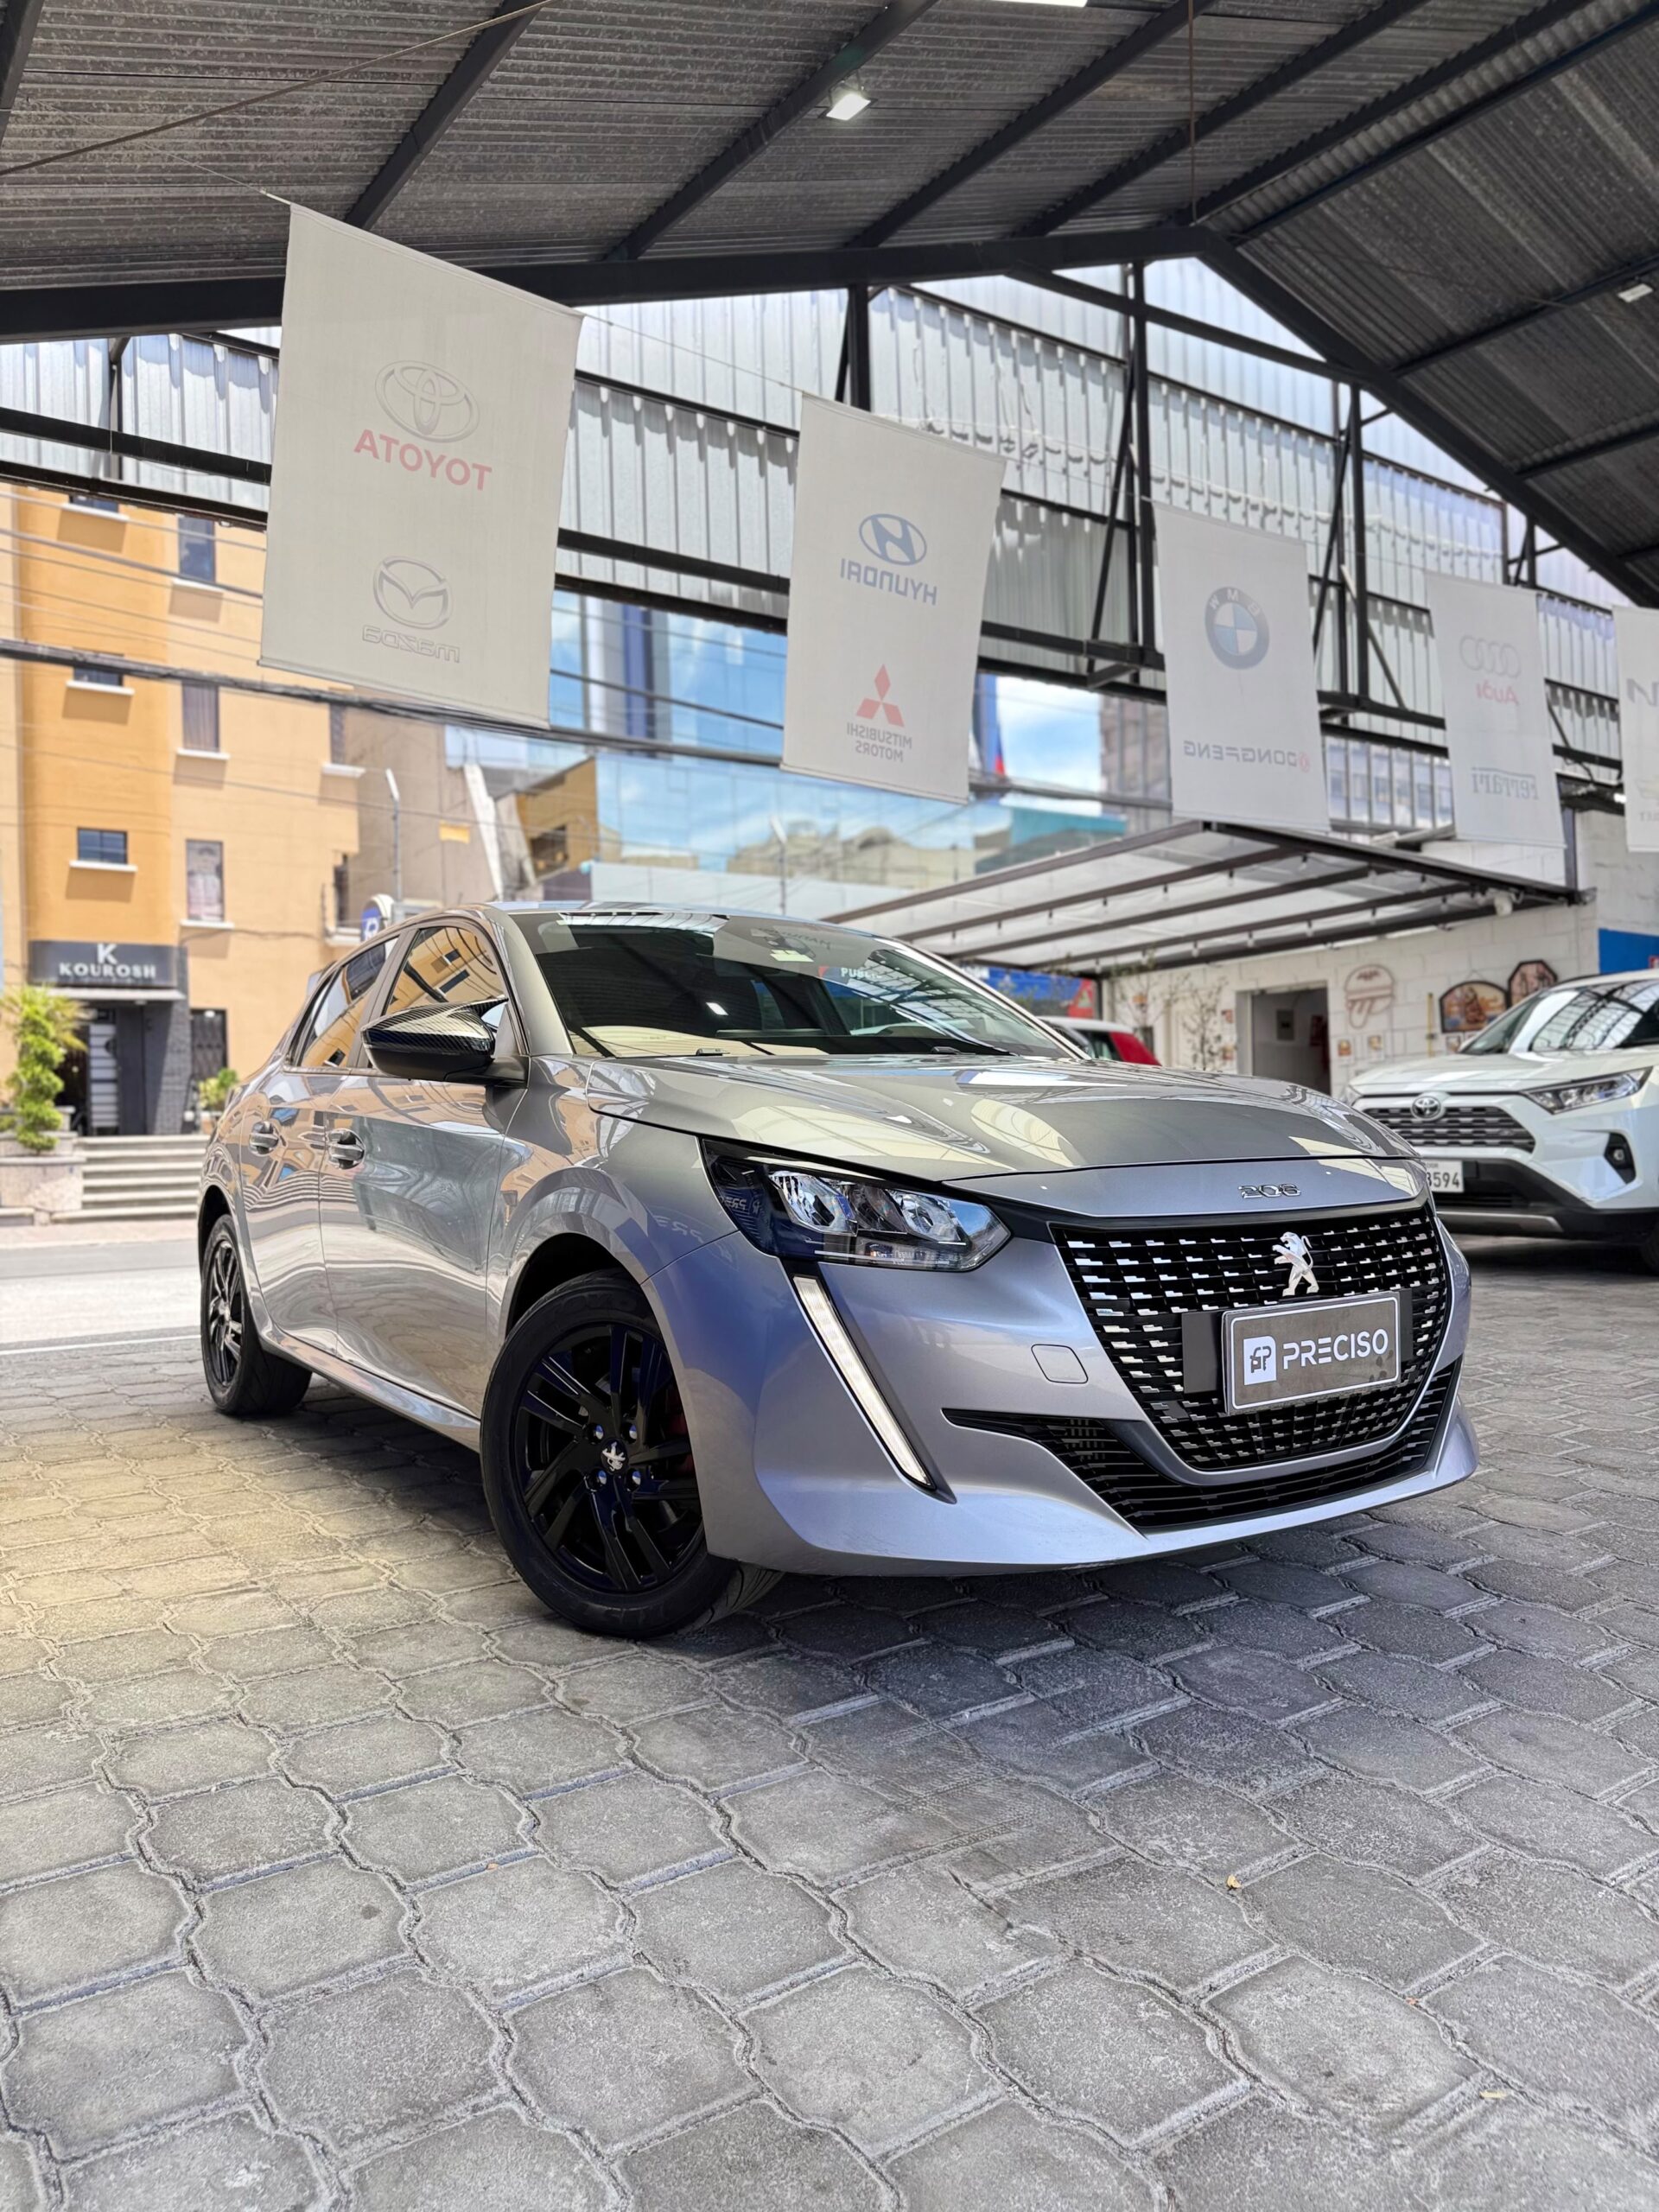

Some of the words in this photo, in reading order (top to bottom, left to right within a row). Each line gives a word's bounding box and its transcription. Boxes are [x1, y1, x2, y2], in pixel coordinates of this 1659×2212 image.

[97, 943, 118, 965] K
[59, 963, 156, 978] KOUROSH
[1238, 1183, 1301, 1198] 208
[1283, 1328, 1389, 1370] PRECISO
